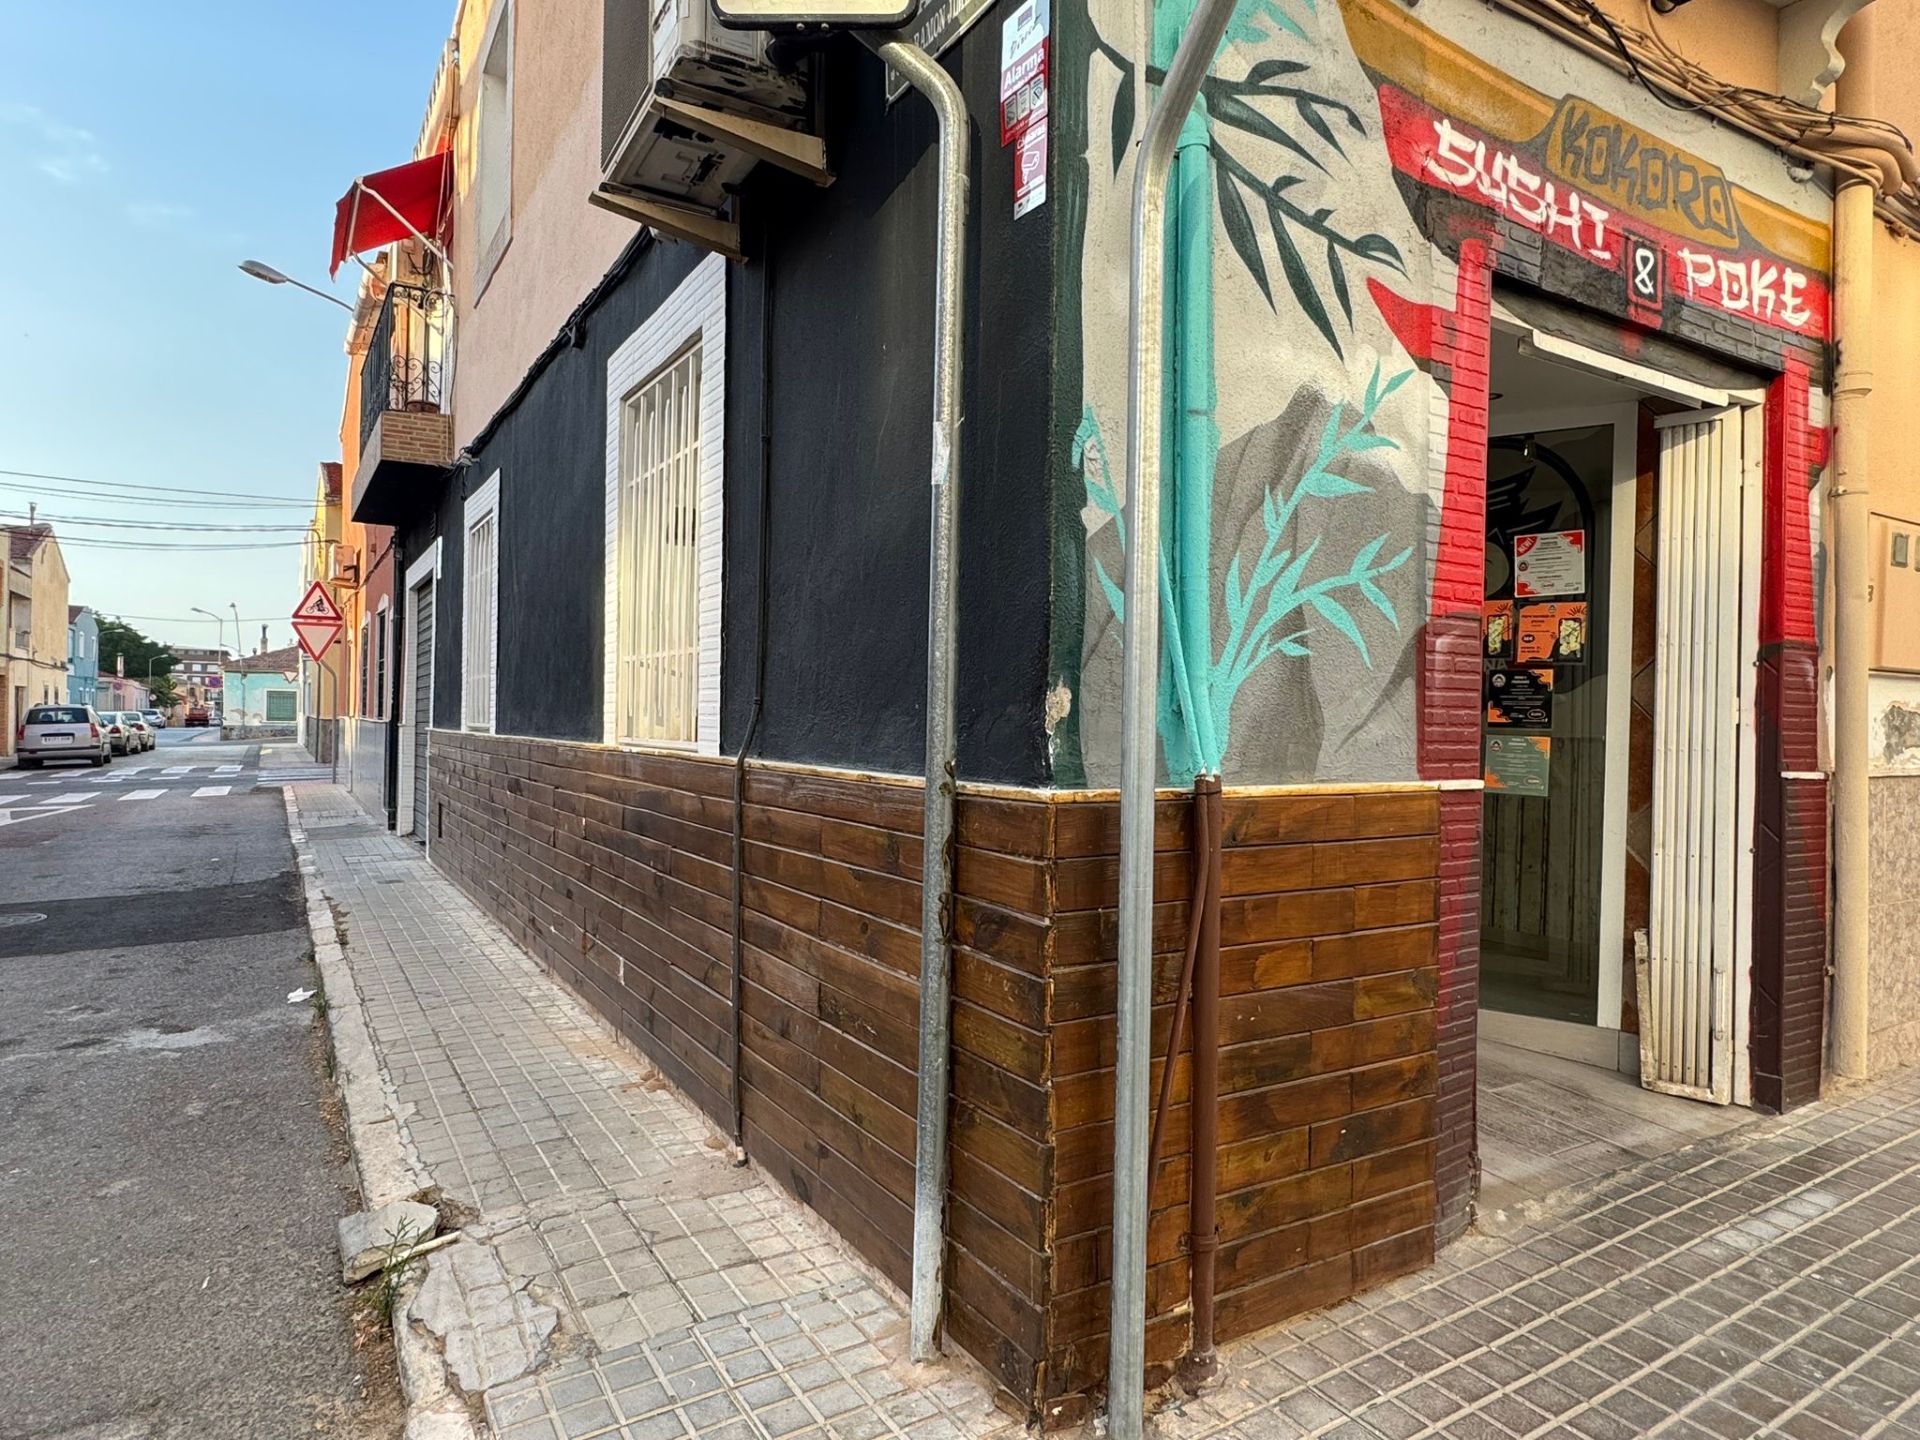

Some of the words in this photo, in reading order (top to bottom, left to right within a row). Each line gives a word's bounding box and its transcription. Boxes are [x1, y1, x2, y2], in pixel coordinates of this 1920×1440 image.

[1003, 48, 1045, 90] Alarma
[1424, 119, 1611, 260] SUSHI
[1635, 248, 1655, 294] &
[1677, 247, 1811, 326] POKE
[1561, 103, 1736, 239] KOKORO
